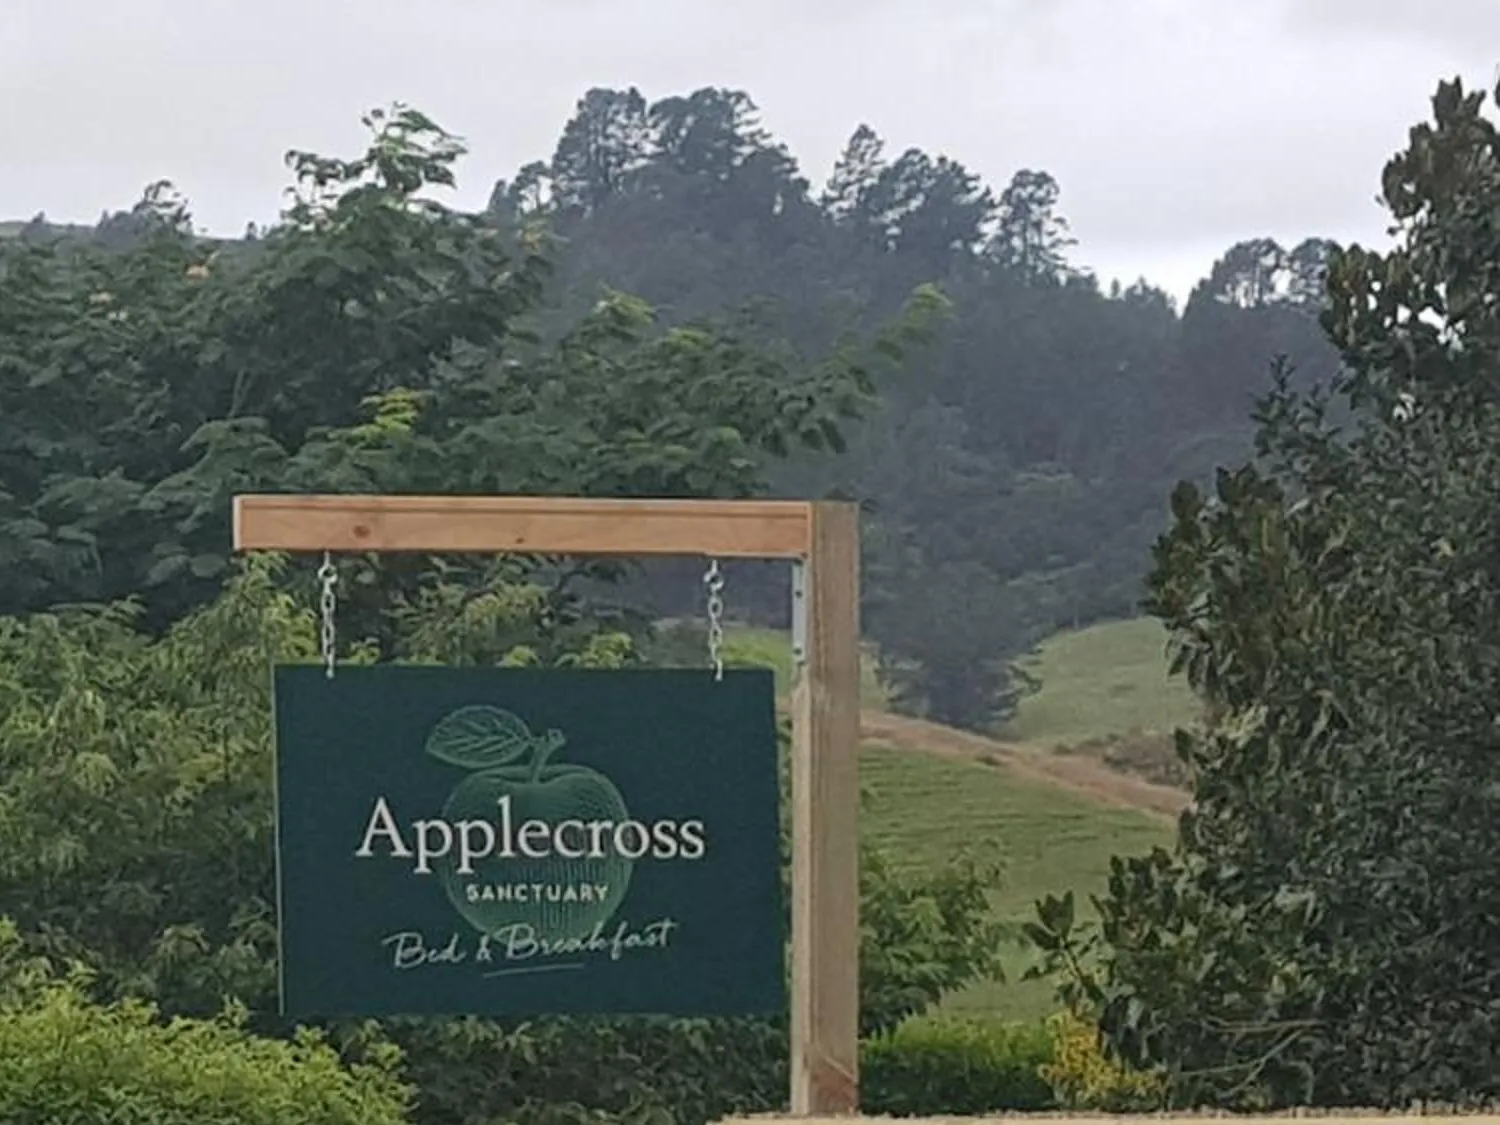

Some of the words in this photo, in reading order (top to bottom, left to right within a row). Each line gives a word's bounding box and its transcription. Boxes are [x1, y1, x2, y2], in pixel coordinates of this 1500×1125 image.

[355, 794, 706, 874] Applecross
[466, 883, 610, 902] SANCTUARY
[380, 932, 467, 968] Bed
[491, 917, 678, 960] Breakfast
